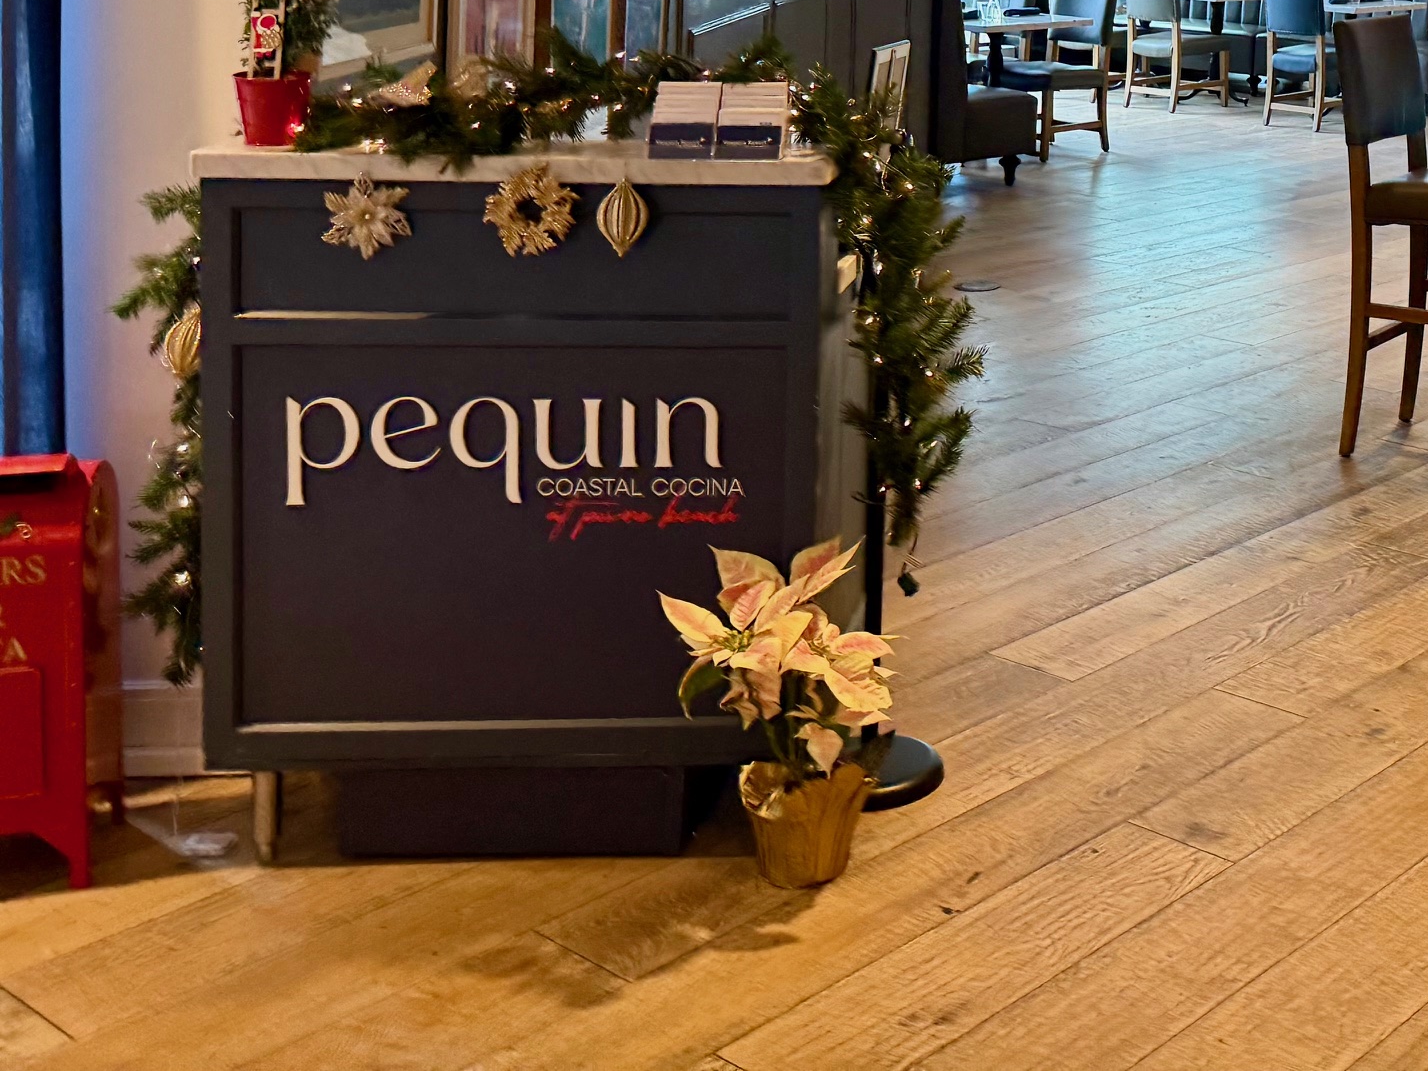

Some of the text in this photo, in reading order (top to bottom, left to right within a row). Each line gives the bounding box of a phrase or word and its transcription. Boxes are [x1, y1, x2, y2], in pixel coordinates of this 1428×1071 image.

[285, 395, 723, 506] pequin
[536, 478, 746, 497] COASTAL COCINA
